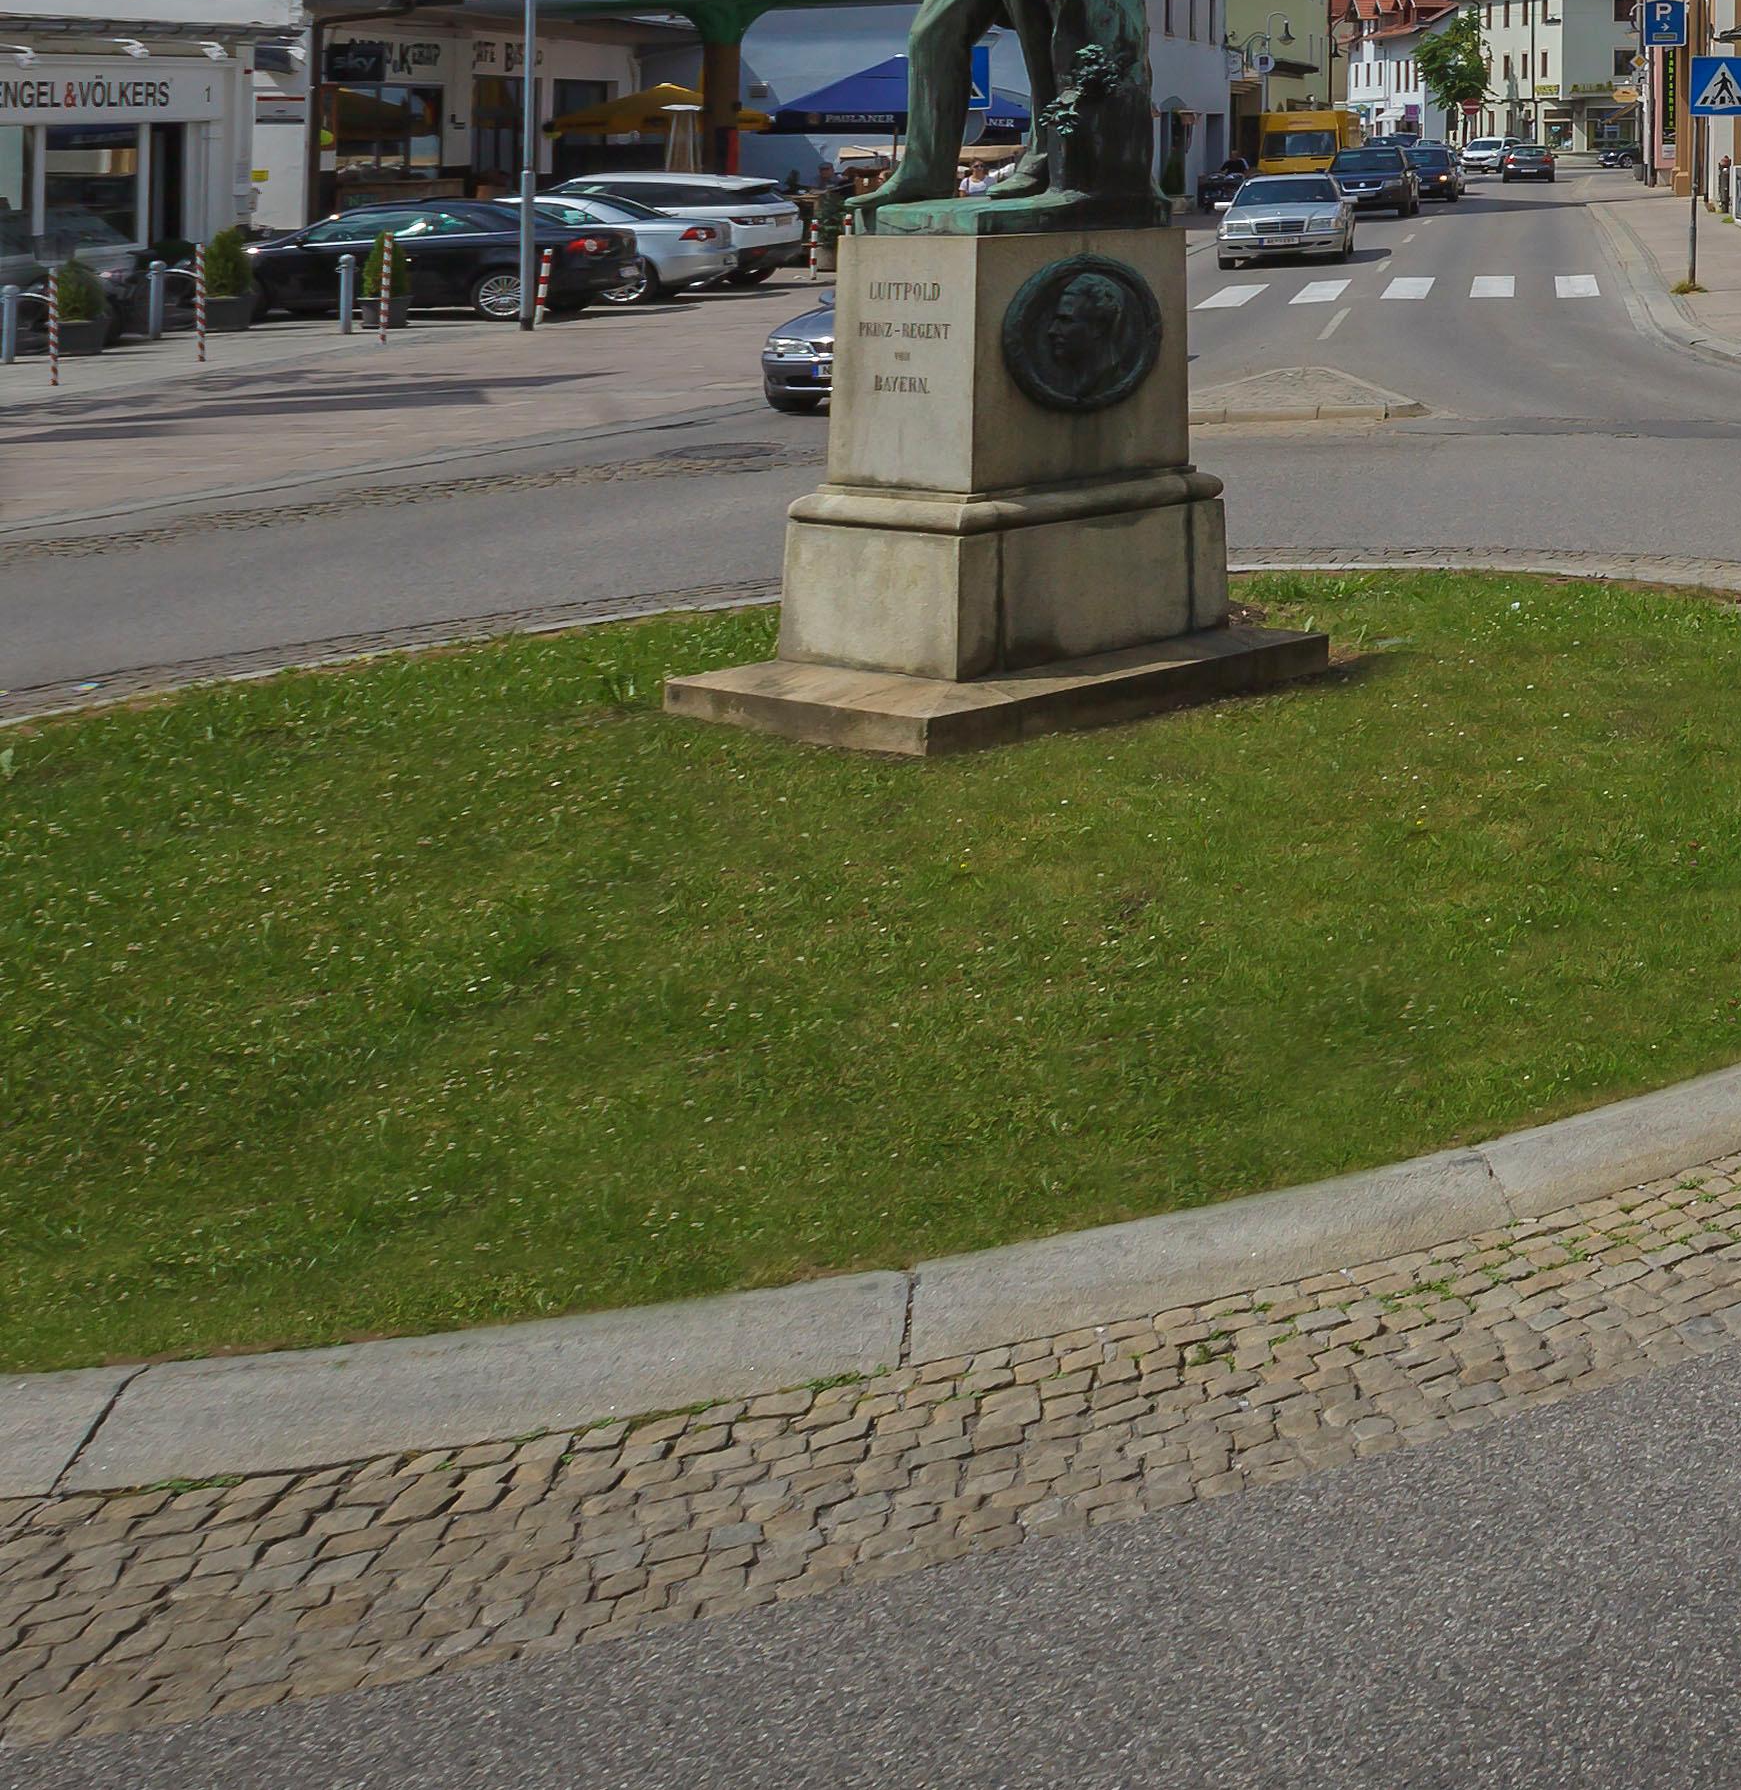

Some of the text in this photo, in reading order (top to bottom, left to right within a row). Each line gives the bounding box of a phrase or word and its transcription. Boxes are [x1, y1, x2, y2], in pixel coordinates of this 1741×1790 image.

[1656, 3, 1672, 21] P
[825, 113, 895, 123] PAULANER
[869, 281, 941, 301] LUITPOLD
